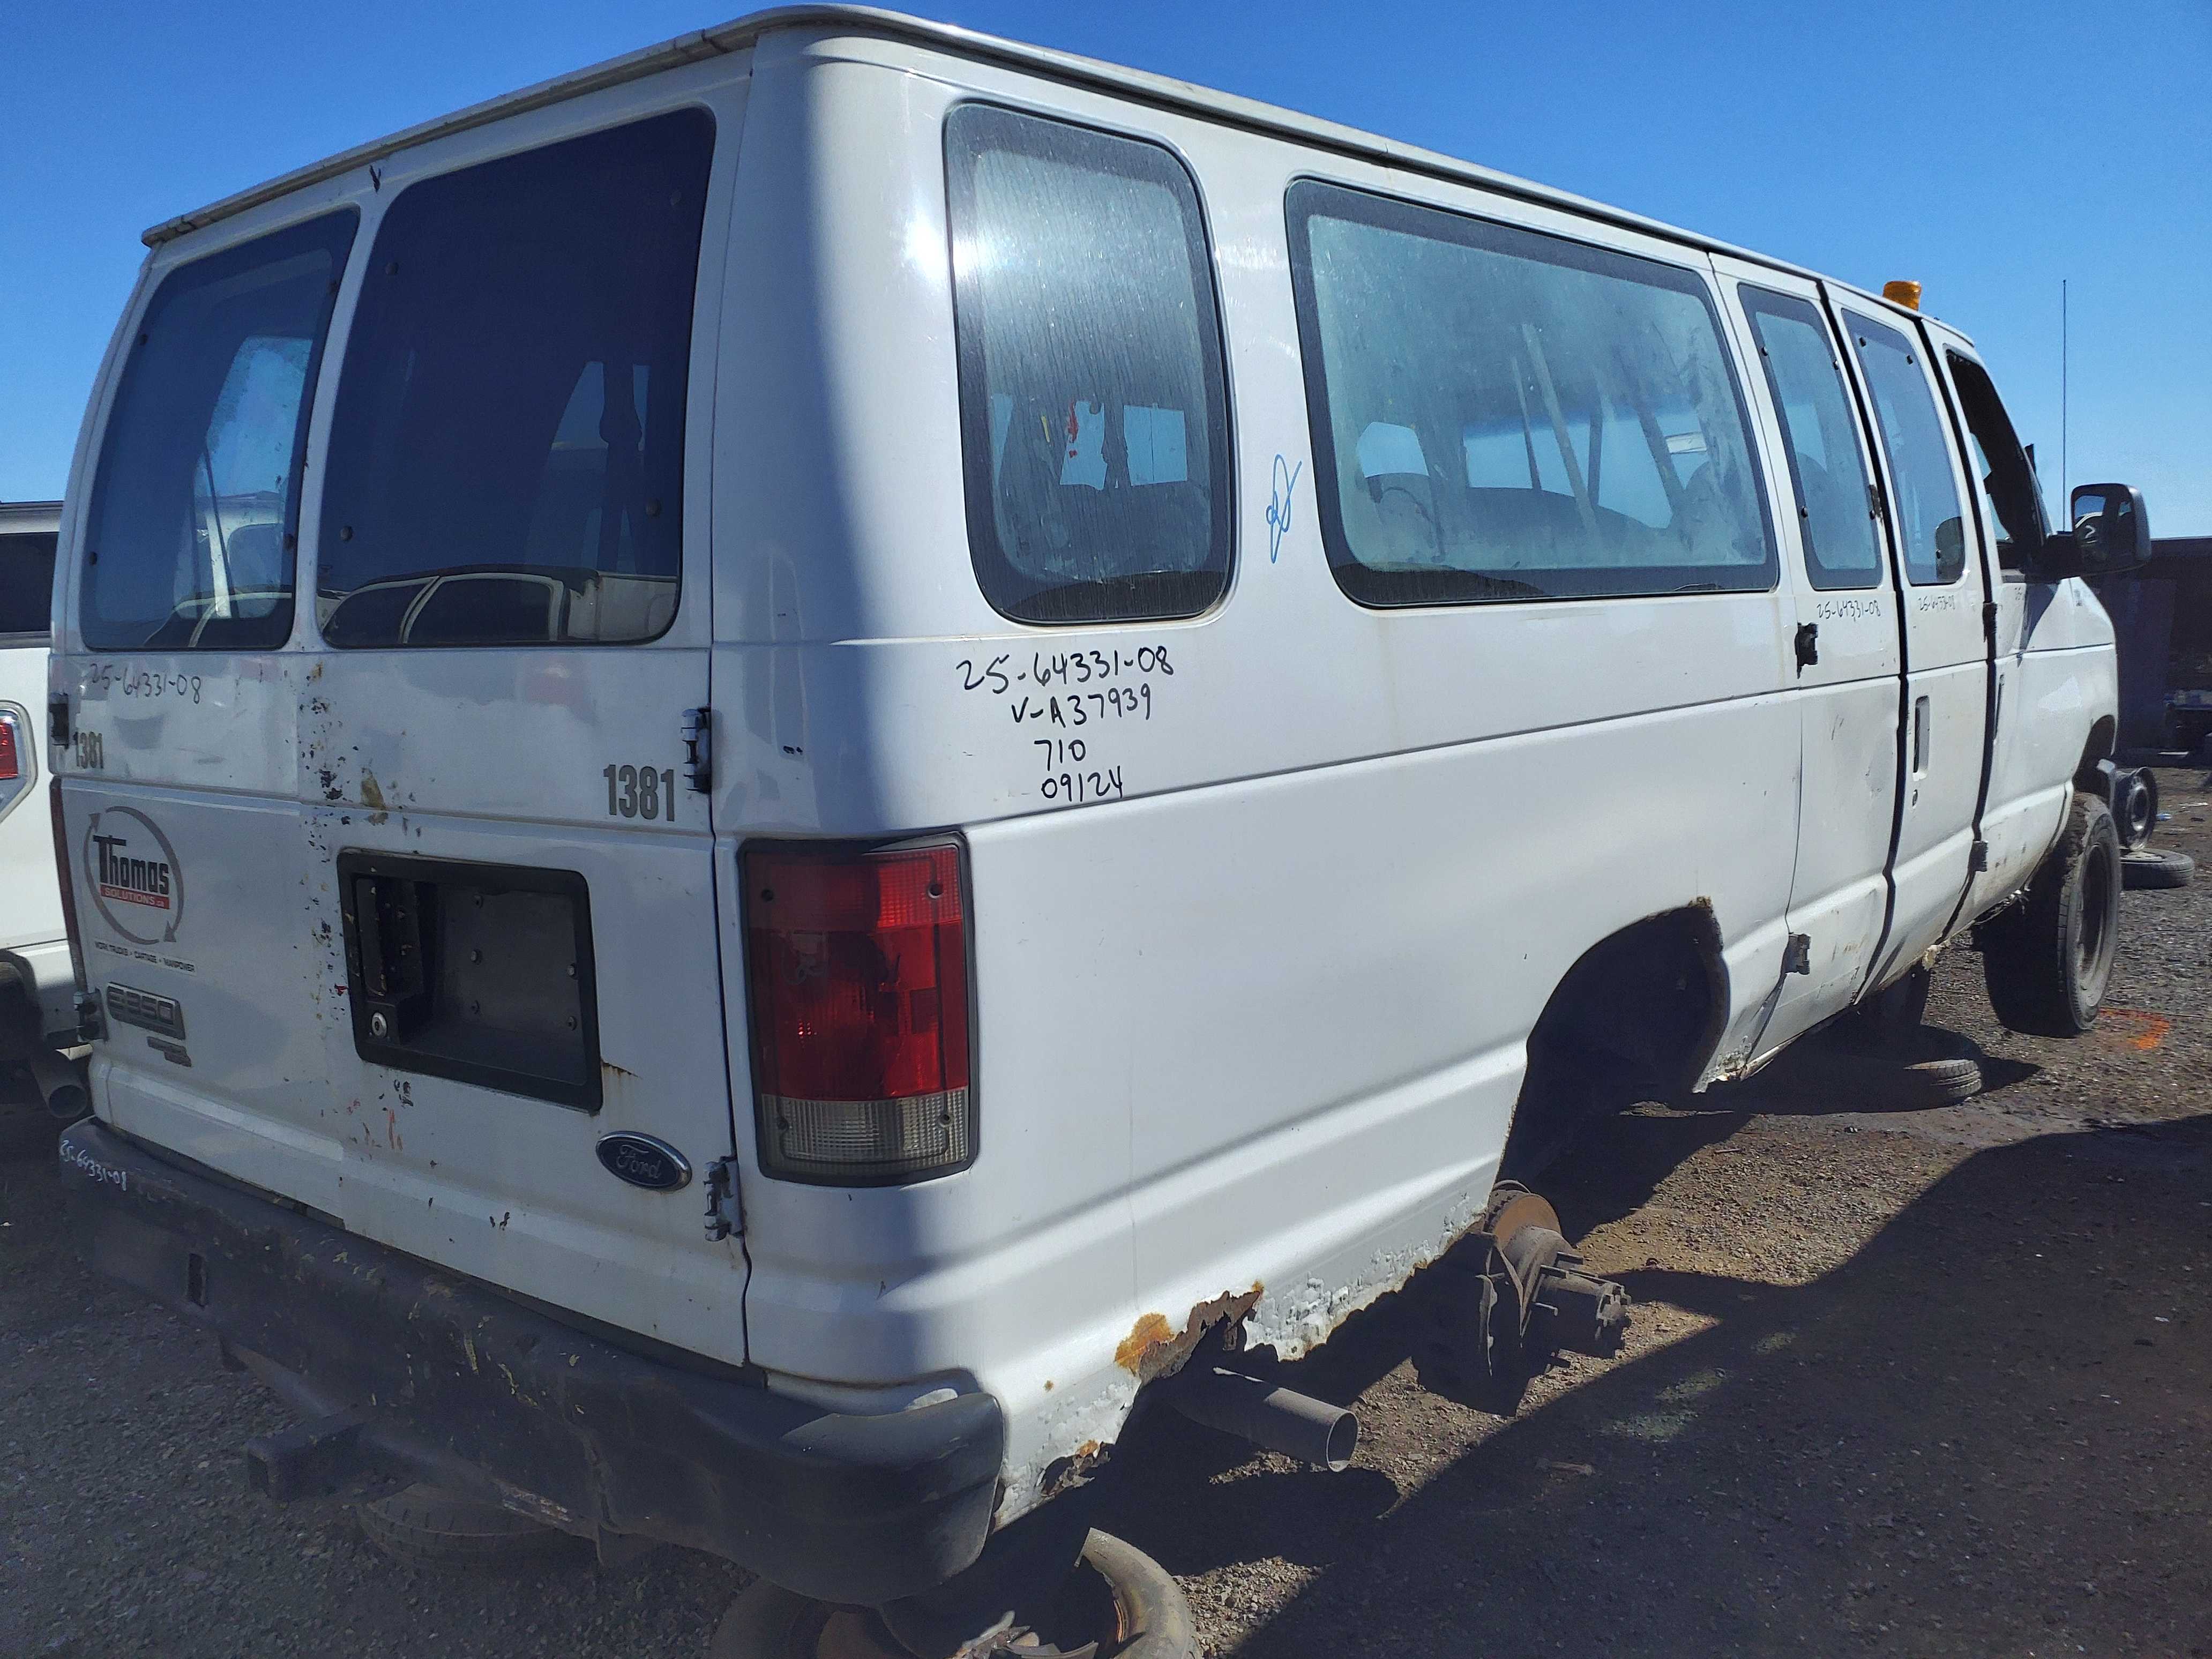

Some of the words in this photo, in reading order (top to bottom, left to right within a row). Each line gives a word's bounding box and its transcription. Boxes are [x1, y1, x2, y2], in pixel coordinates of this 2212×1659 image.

[1817, 600, 1881, 620] 25-64331-08
[90, 663, 201, 704] 25-64331-08
[956, 645, 1174, 693] 25-64331-08
[1011, 683, 1152, 728] V-A37939
[73, 731, 104, 769] 1381
[1034, 739, 1086, 771] 710
[603, 764, 675, 822] 1381
[1041, 765, 1124, 802] 09124
[93, 834, 169, 895] Thomas
[616, 1144, 662, 1179] Ford
